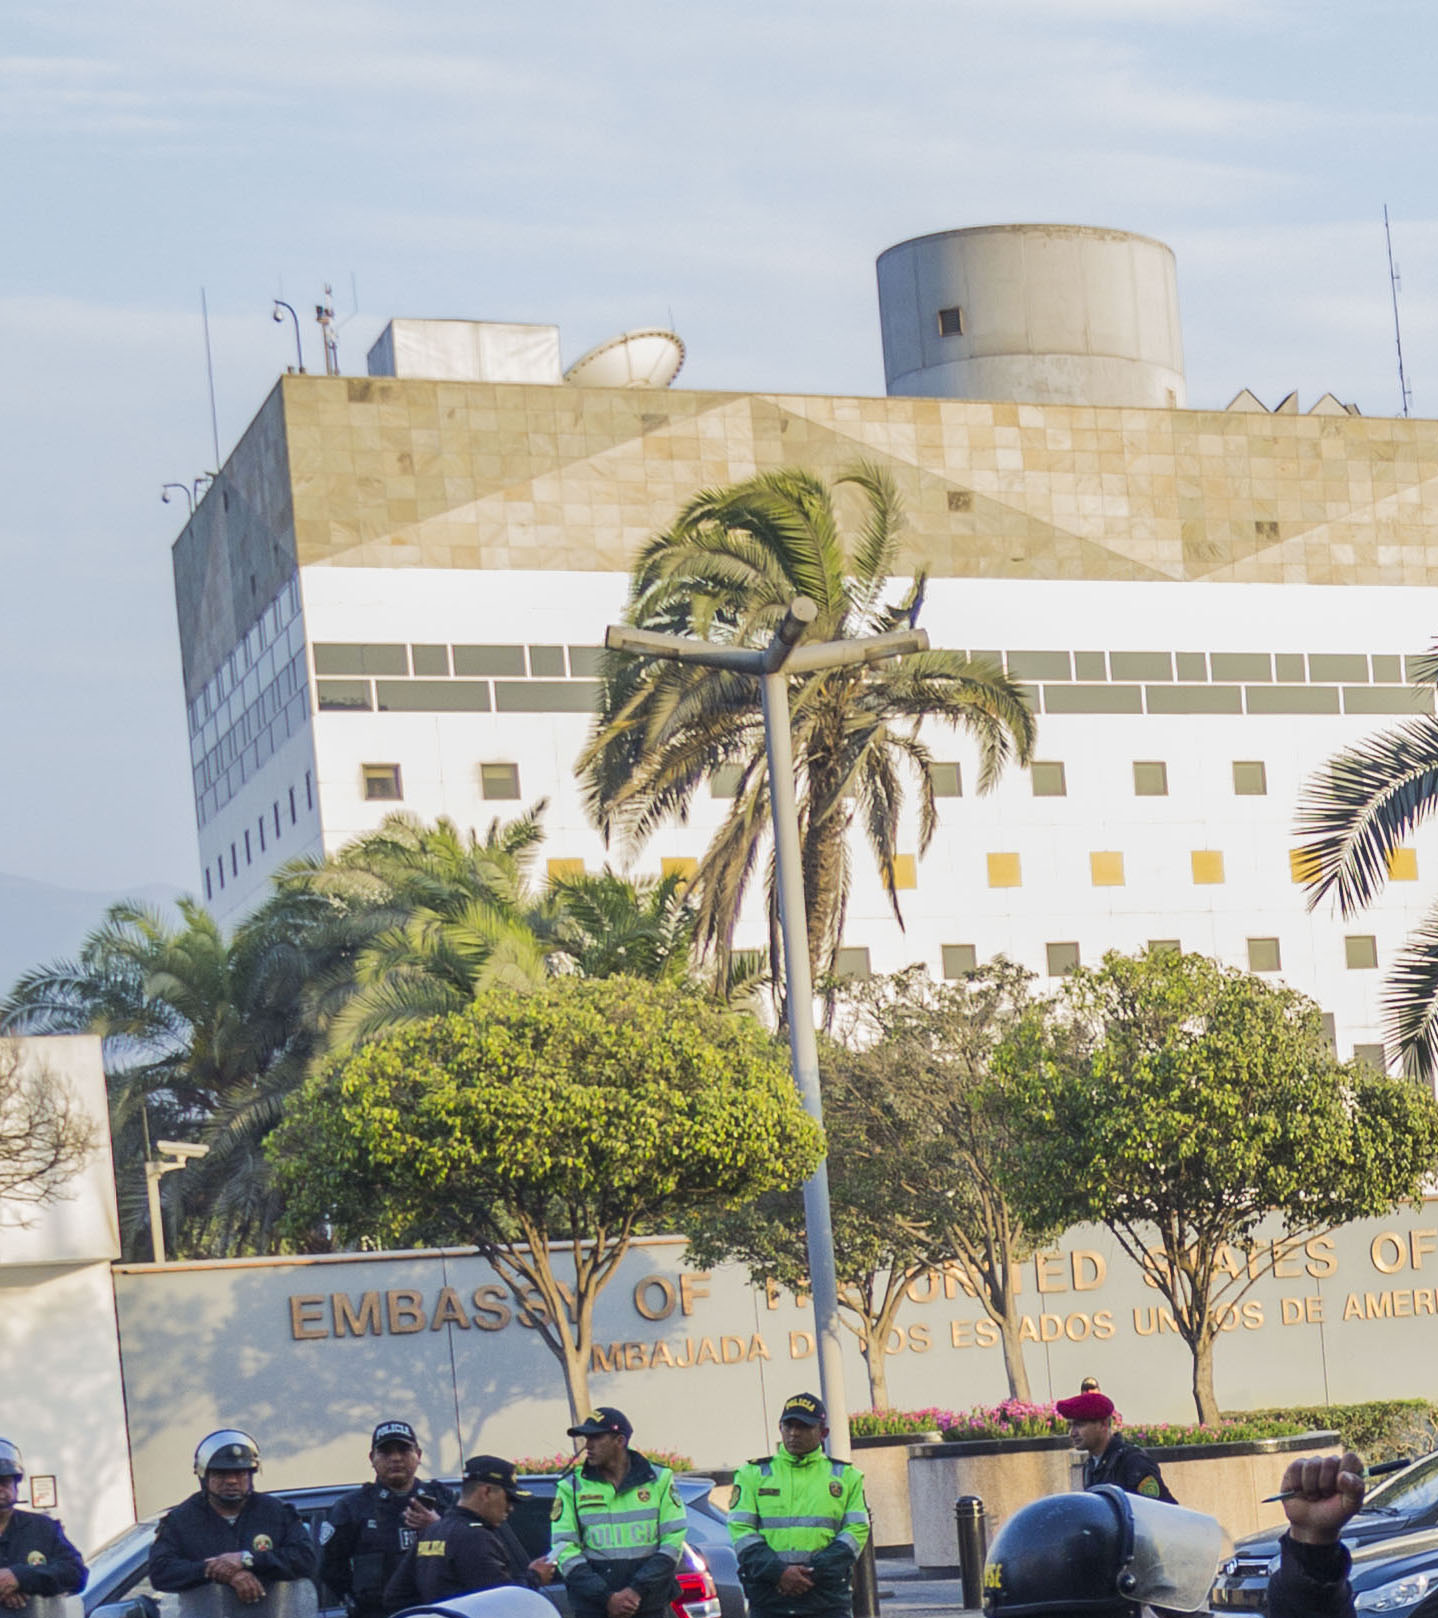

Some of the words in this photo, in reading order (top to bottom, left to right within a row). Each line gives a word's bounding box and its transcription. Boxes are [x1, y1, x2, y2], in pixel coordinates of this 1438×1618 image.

[635, 1272, 712, 1321] OF
[1369, 1228, 1438, 1275] OF
[590, 1332, 771, 1373] MBAJADA
[788, 1330, 817, 1360] D
[950, 1309, 1116, 1349] ESADOS
[1133, 1300, 1265, 1337] UNOS
[1280, 1295, 1326, 1326] DE
